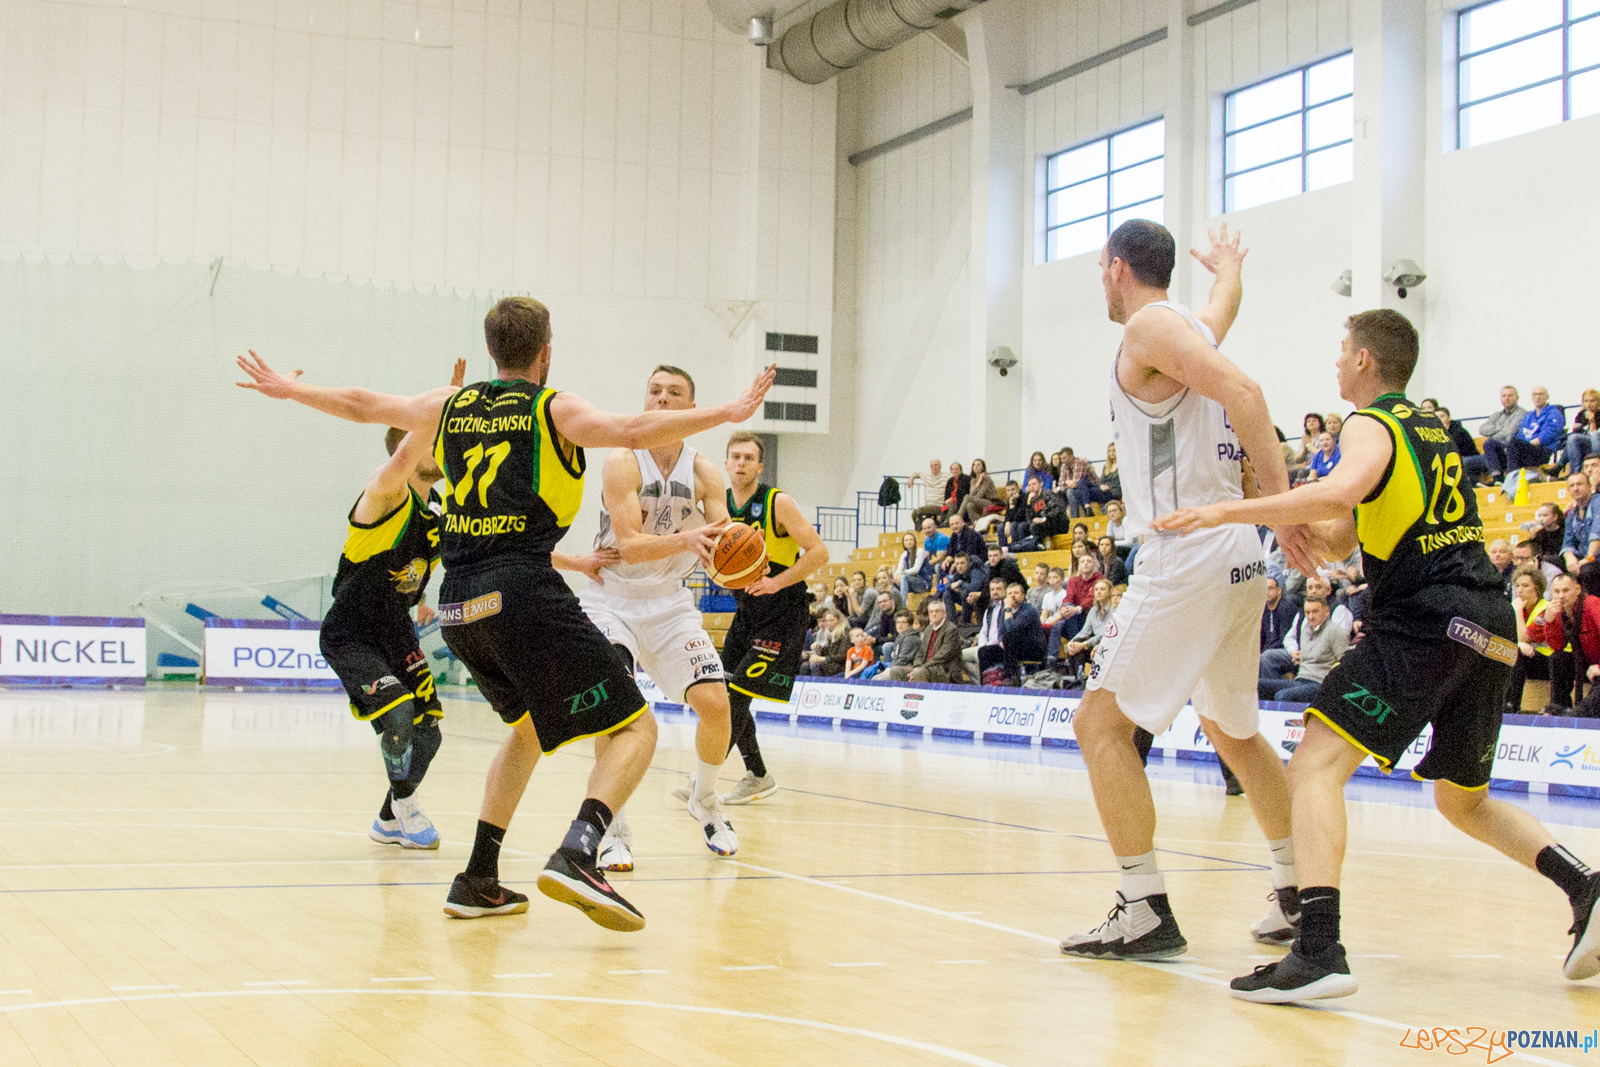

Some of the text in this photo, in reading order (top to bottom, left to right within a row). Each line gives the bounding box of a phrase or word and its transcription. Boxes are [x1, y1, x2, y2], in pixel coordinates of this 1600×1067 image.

[1426, 452, 1465, 524] 18
[16, 639, 136, 664] NICKEL
[746, 661, 768, 678] 0
[416, 674, 434, 702] 4
[563, 678, 609, 715] ZOT
[854, 696, 885, 712] NICKEL
[1341, 682, 1398, 724] ZOT
[1497, 743, 1542, 763] DELIK
